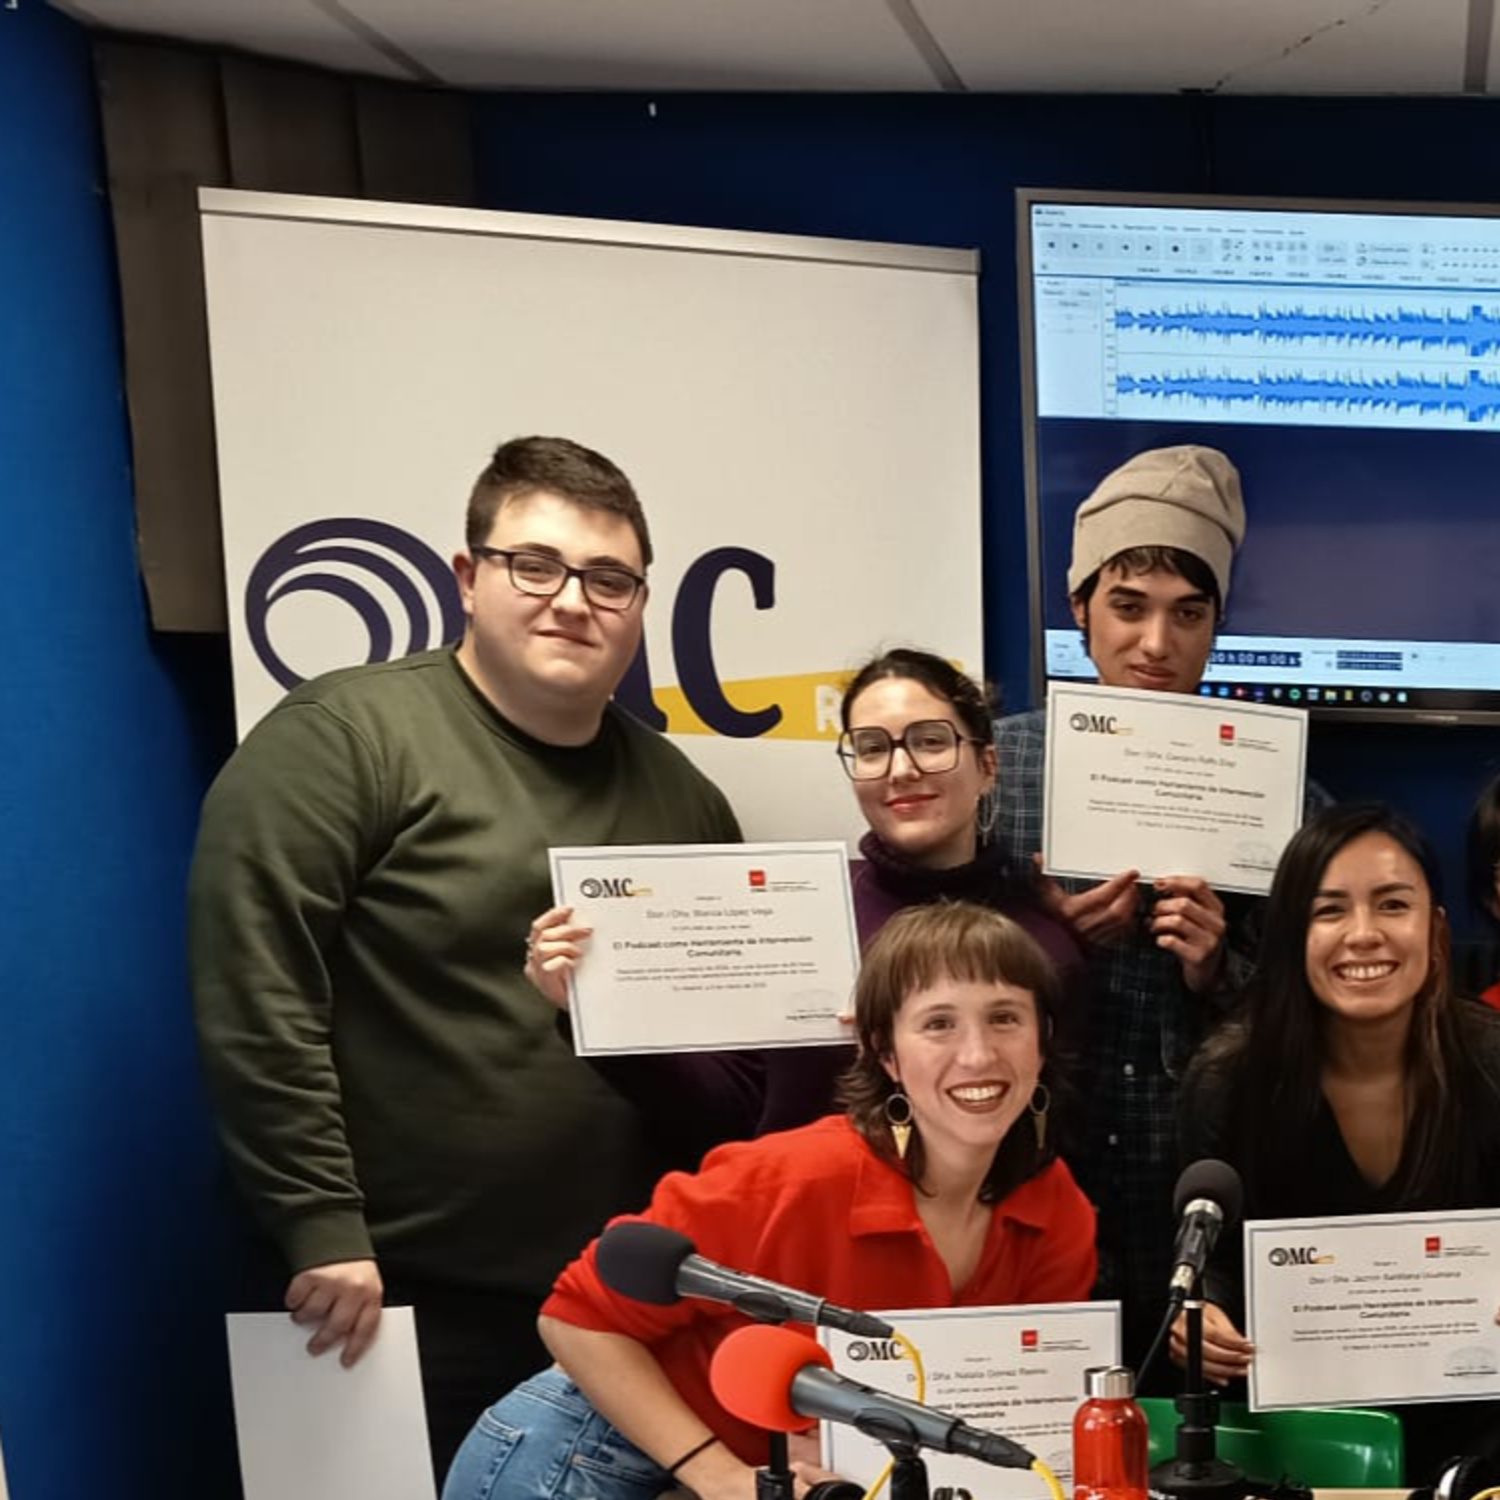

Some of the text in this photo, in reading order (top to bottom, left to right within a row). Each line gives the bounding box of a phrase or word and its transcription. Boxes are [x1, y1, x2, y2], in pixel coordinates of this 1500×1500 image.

[1070, 712, 1117, 734] OMC
[579, 877, 633, 897] OMC
[1269, 1246, 1316, 1265] OMC
[847, 1341, 902, 1361] OMC
